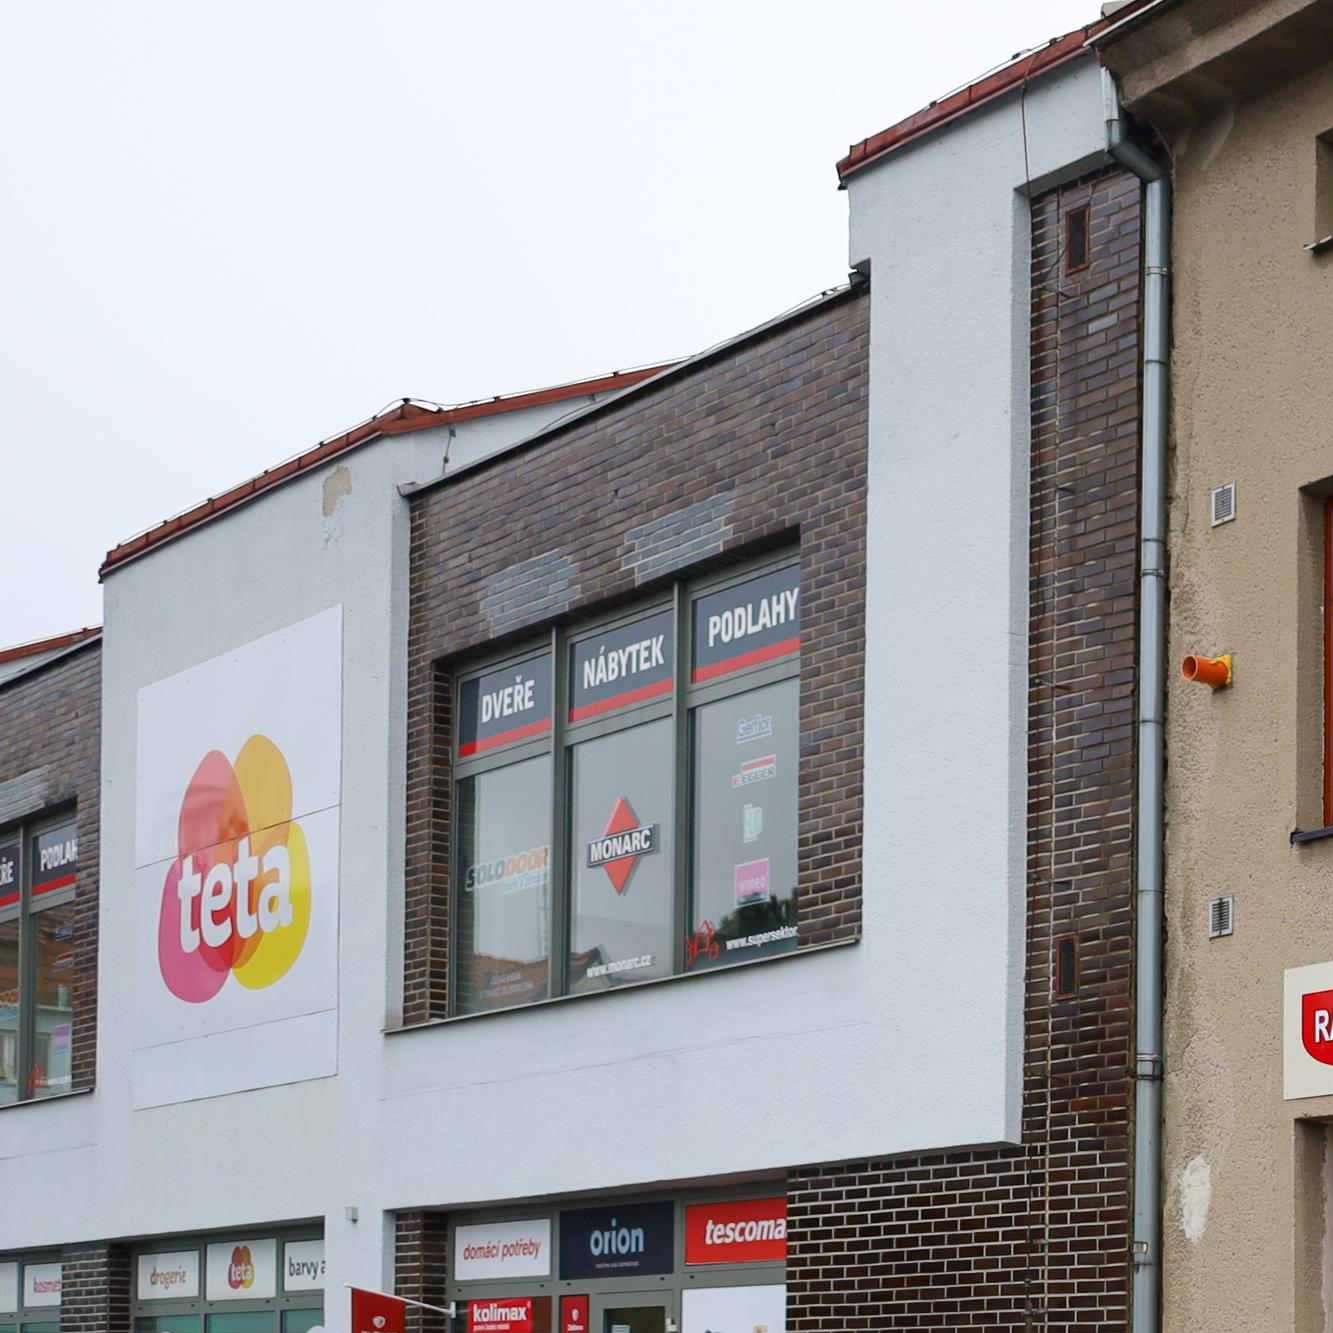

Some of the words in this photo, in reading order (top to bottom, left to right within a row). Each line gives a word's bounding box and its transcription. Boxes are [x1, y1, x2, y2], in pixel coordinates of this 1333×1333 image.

[708, 587, 799, 648] PODLAHY
[583, 634, 665, 690] NÁBYTEK
[482, 674, 536, 724] DVEŘE
[591, 829, 651, 862] MONARC
[178, 836, 293, 954] teta
[586, 955, 651, 978] www.monarc.cz
[590, 1217, 644, 1256] orion
[705, 1218, 787, 1245] tescoma
[463, 1239, 500, 1260] domácí
[501, 1238, 541, 1262] potřeby
[288, 1256, 319, 1280] barvy
[473, 1302, 527, 1322] kolimax
